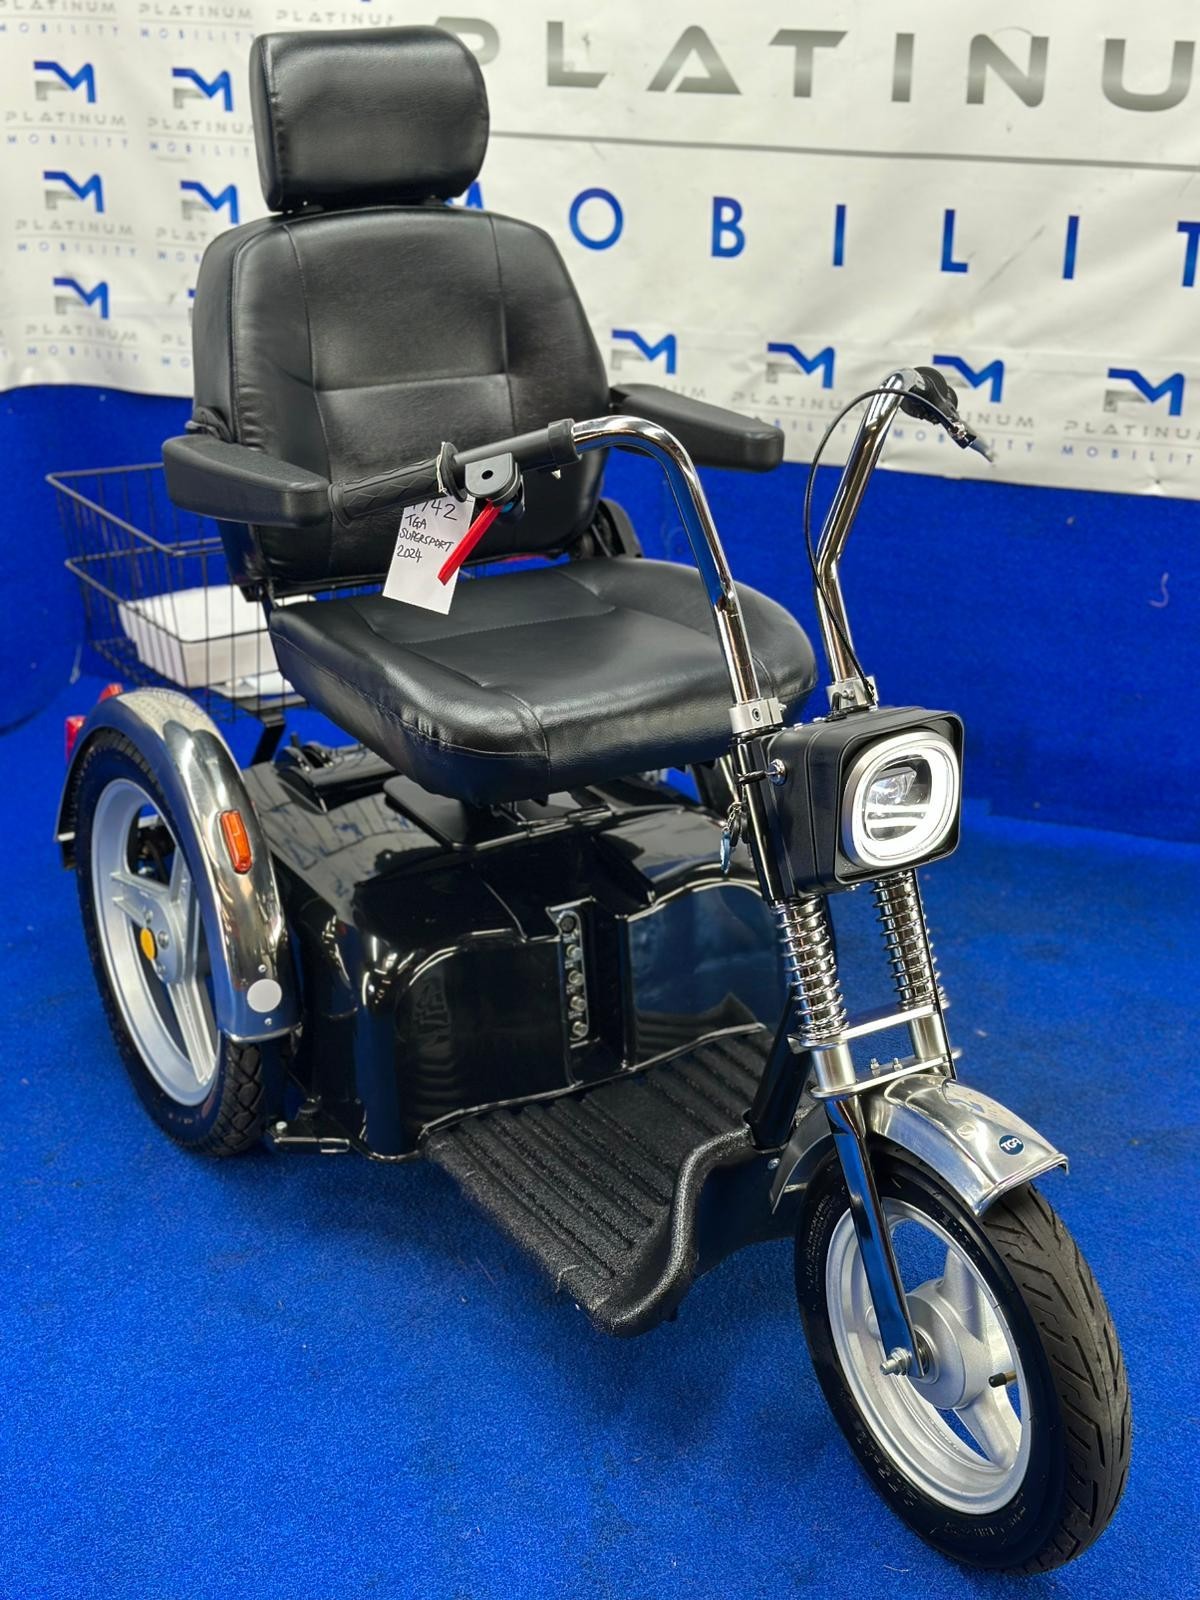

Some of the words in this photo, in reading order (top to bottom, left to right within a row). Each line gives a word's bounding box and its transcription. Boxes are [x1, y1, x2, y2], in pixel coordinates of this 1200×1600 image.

[138, 3, 253, 19] PLATINUM
[5, 111, 127, 127] PLATINUM
[15, 219, 134, 236] PLATINUM
[25, 324, 138, 343] PLATINUM
[405, 513, 427, 530] TGA
[399, 527, 455, 552] SUPERSPORT
[397, 544, 423, 563] 2024
